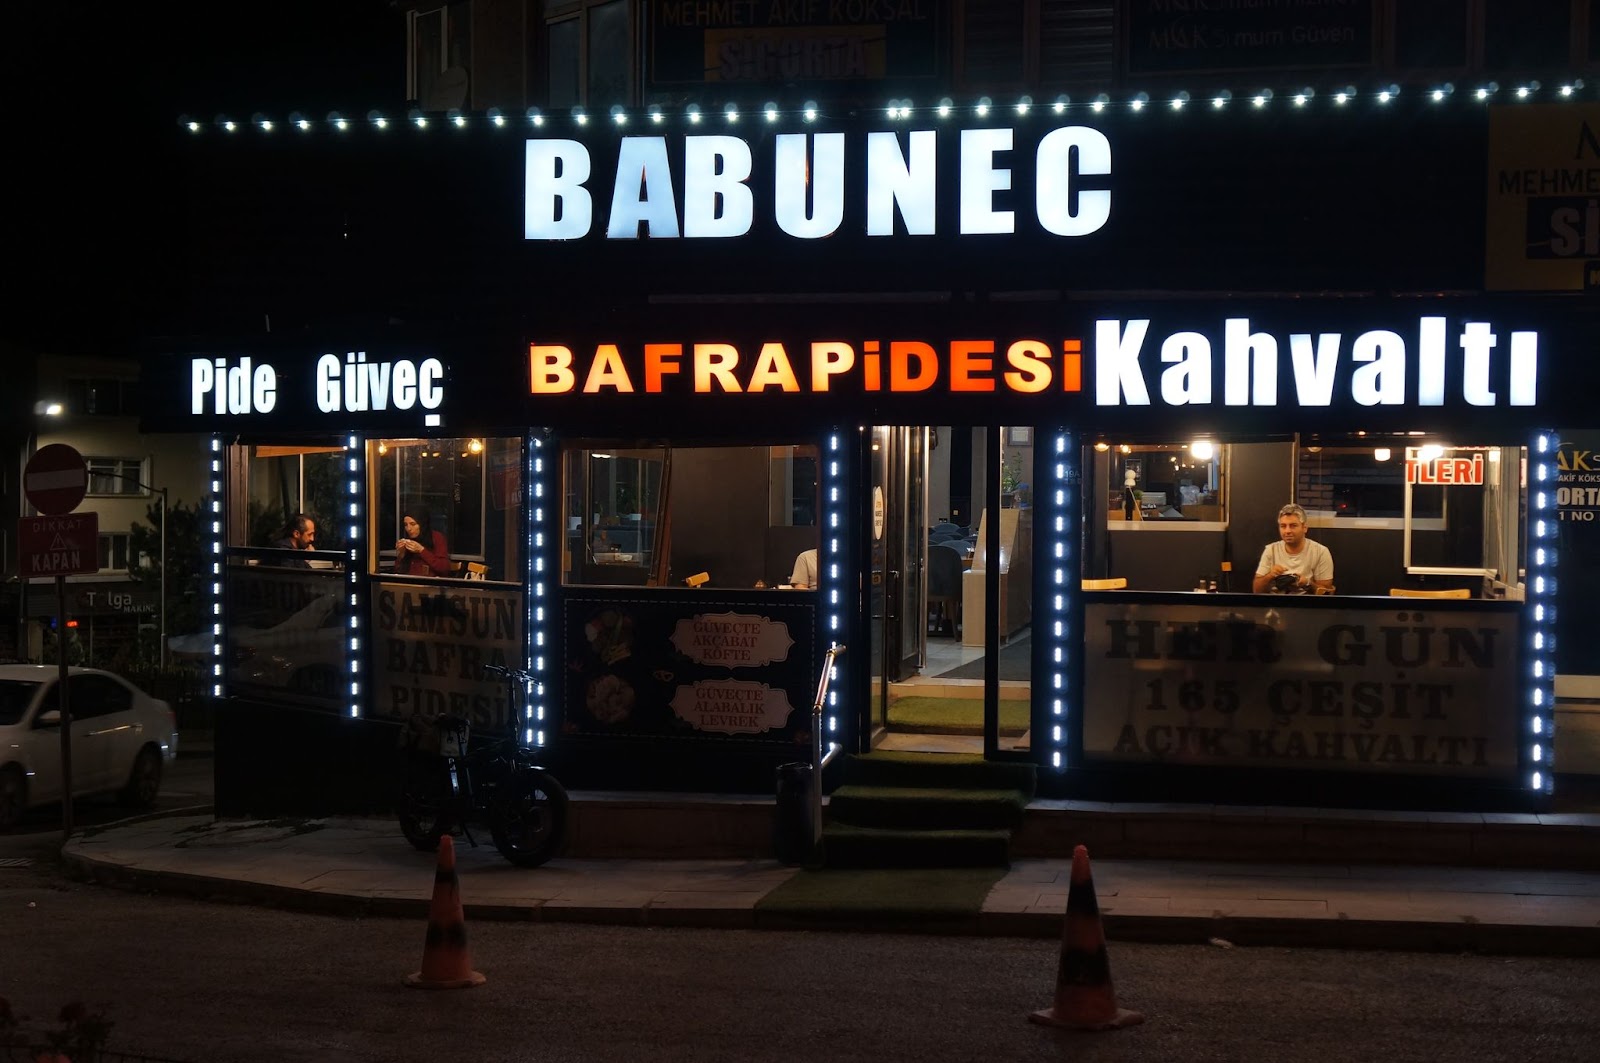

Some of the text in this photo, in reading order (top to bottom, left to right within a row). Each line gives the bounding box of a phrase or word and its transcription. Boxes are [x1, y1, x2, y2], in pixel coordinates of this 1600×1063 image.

[663, 1, 759, 27] MEHMET
[525, 126, 1112, 240] BABUNEC
[1095, 316, 1538, 407] Kahvaltı
[191, 351, 444, 427] Pide Güveç
[31, 551, 81, 573] KAPAN
[379, 590, 518, 641] SAMSUN
[693, 620, 761, 638] GÜVEÇTE
[385, 638, 510, 682] BAFRA
[692, 635, 758, 650] AKÇABAT
[1105, 612, 1499, 668] HER GÜN
[694, 701, 765, 715] ALABALIK
[696, 686, 763, 704] GÜVEÇTE
[1145, 672, 1454, 730] 165 ÇEŞİT
[701, 714, 759, 728] LEVREK
[1113, 724, 1489, 768] AÇIK KAHVALTI
